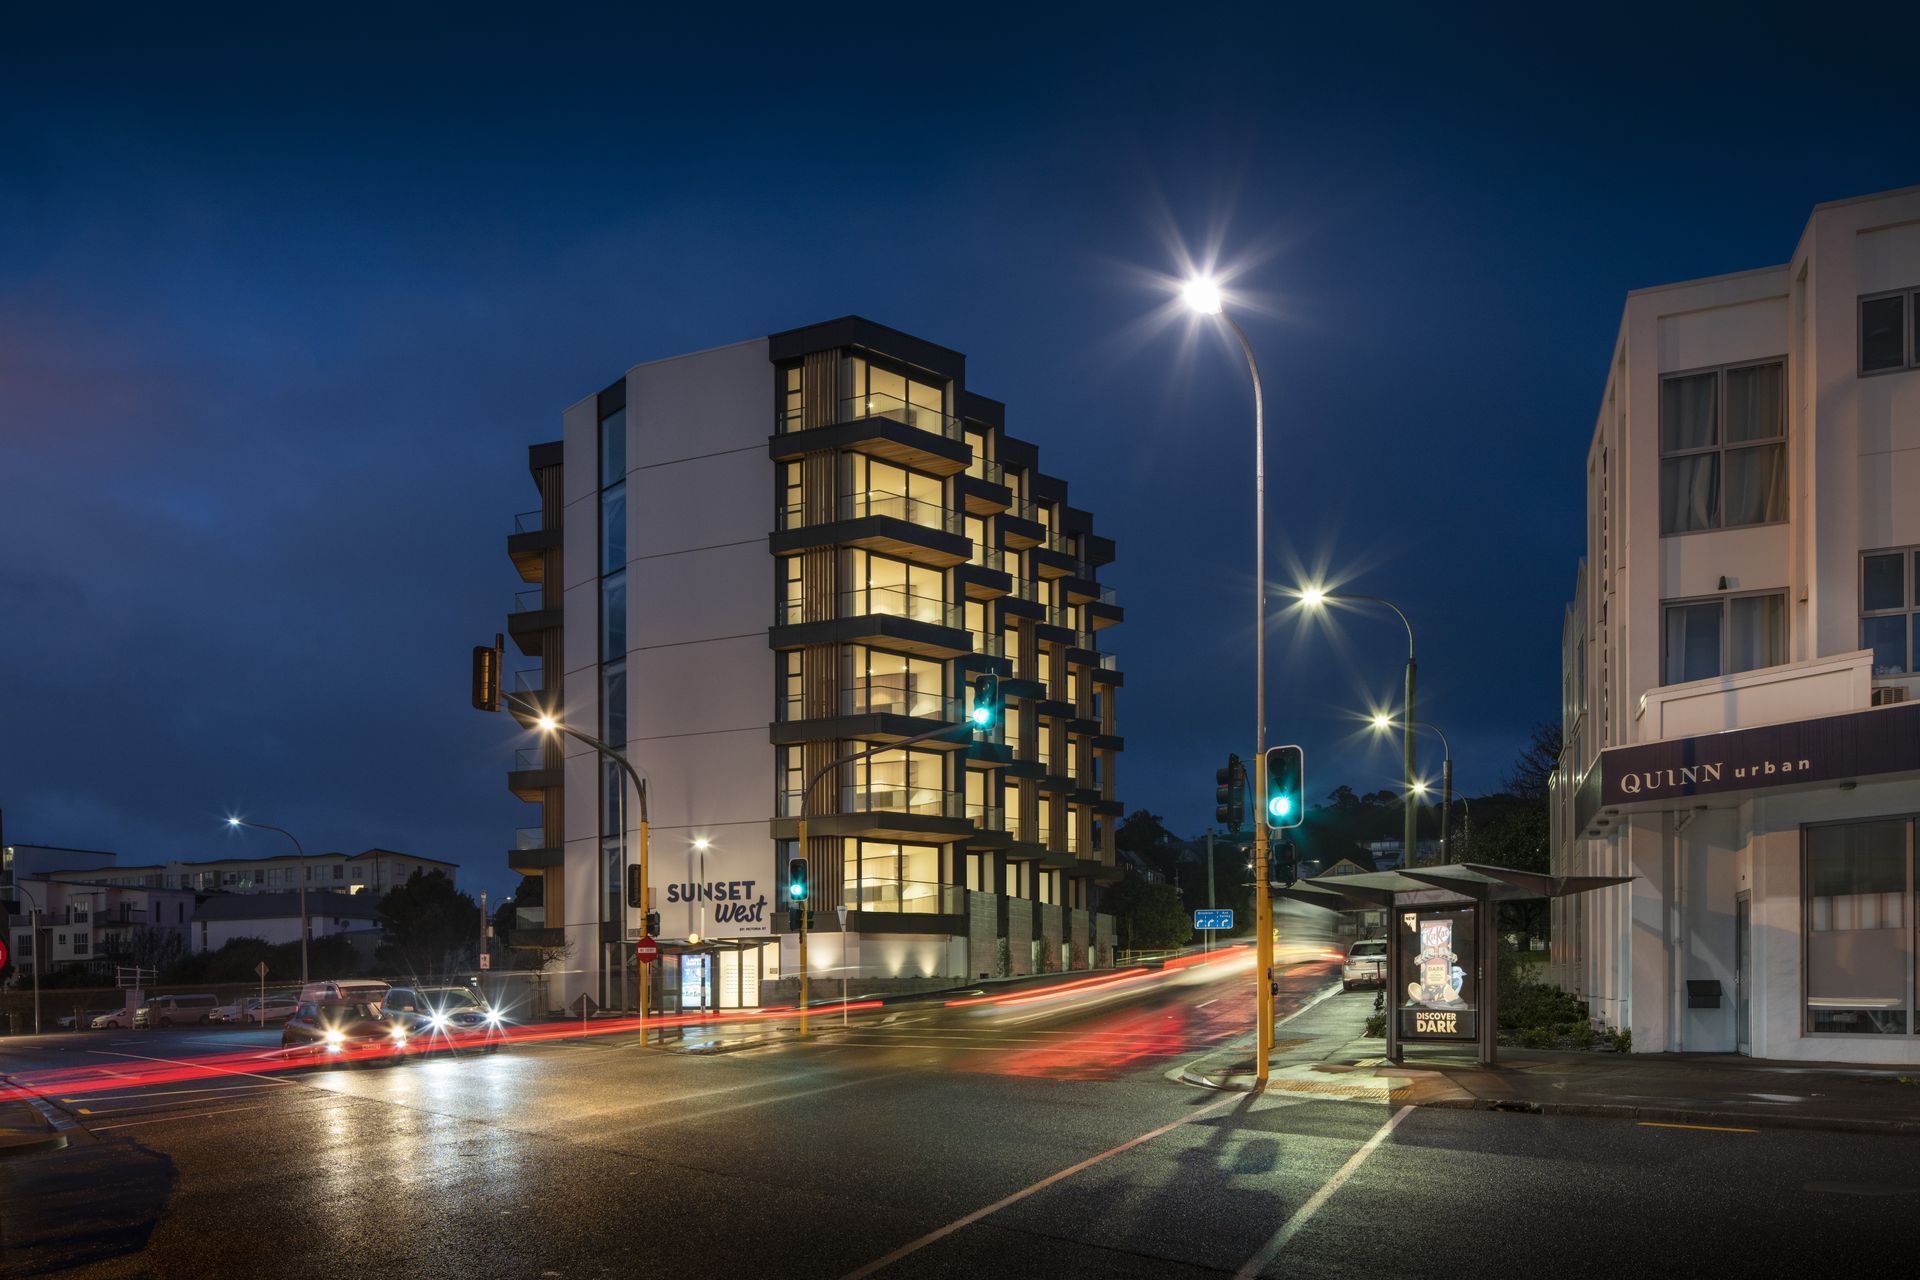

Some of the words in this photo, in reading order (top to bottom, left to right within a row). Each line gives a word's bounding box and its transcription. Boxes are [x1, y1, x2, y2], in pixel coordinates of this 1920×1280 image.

[1620, 762, 1724, 794] QUINN
[1734, 759, 1811, 778] urban
[667, 880, 756, 903] SUNSET
[714, 894, 768, 923] west
[1416, 1012, 1457, 1020] DISCOVER
[1416, 1020, 1457, 1033] DARK
